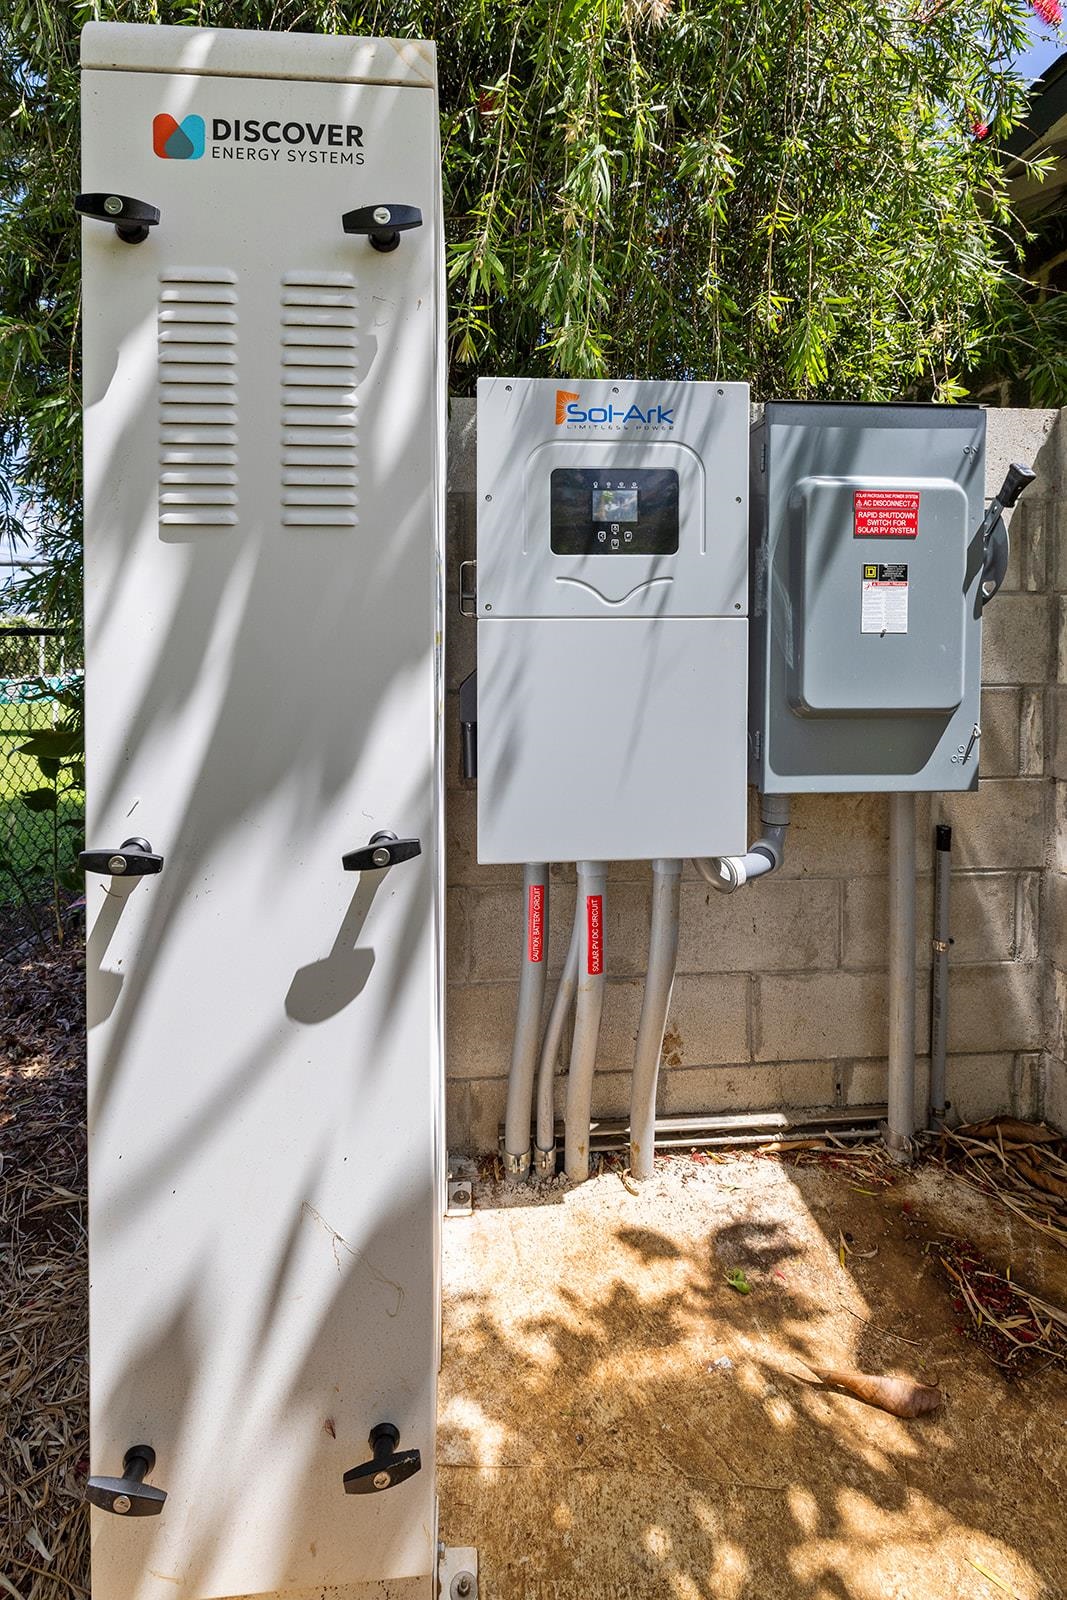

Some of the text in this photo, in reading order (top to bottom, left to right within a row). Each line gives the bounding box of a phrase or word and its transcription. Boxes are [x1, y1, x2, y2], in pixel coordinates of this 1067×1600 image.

[212, 118, 364, 147] DISCOVER
[212, 146, 365, 165] ENERGY SYSTEMS
[567, 403, 674, 424] Sol-Ark
[878, 511, 915, 519] SHUTDOWN
[591, 899, 599, 928] CIRCUIT
[592, 928, 599, 939] DC
[592, 940, 599, 949] PV
